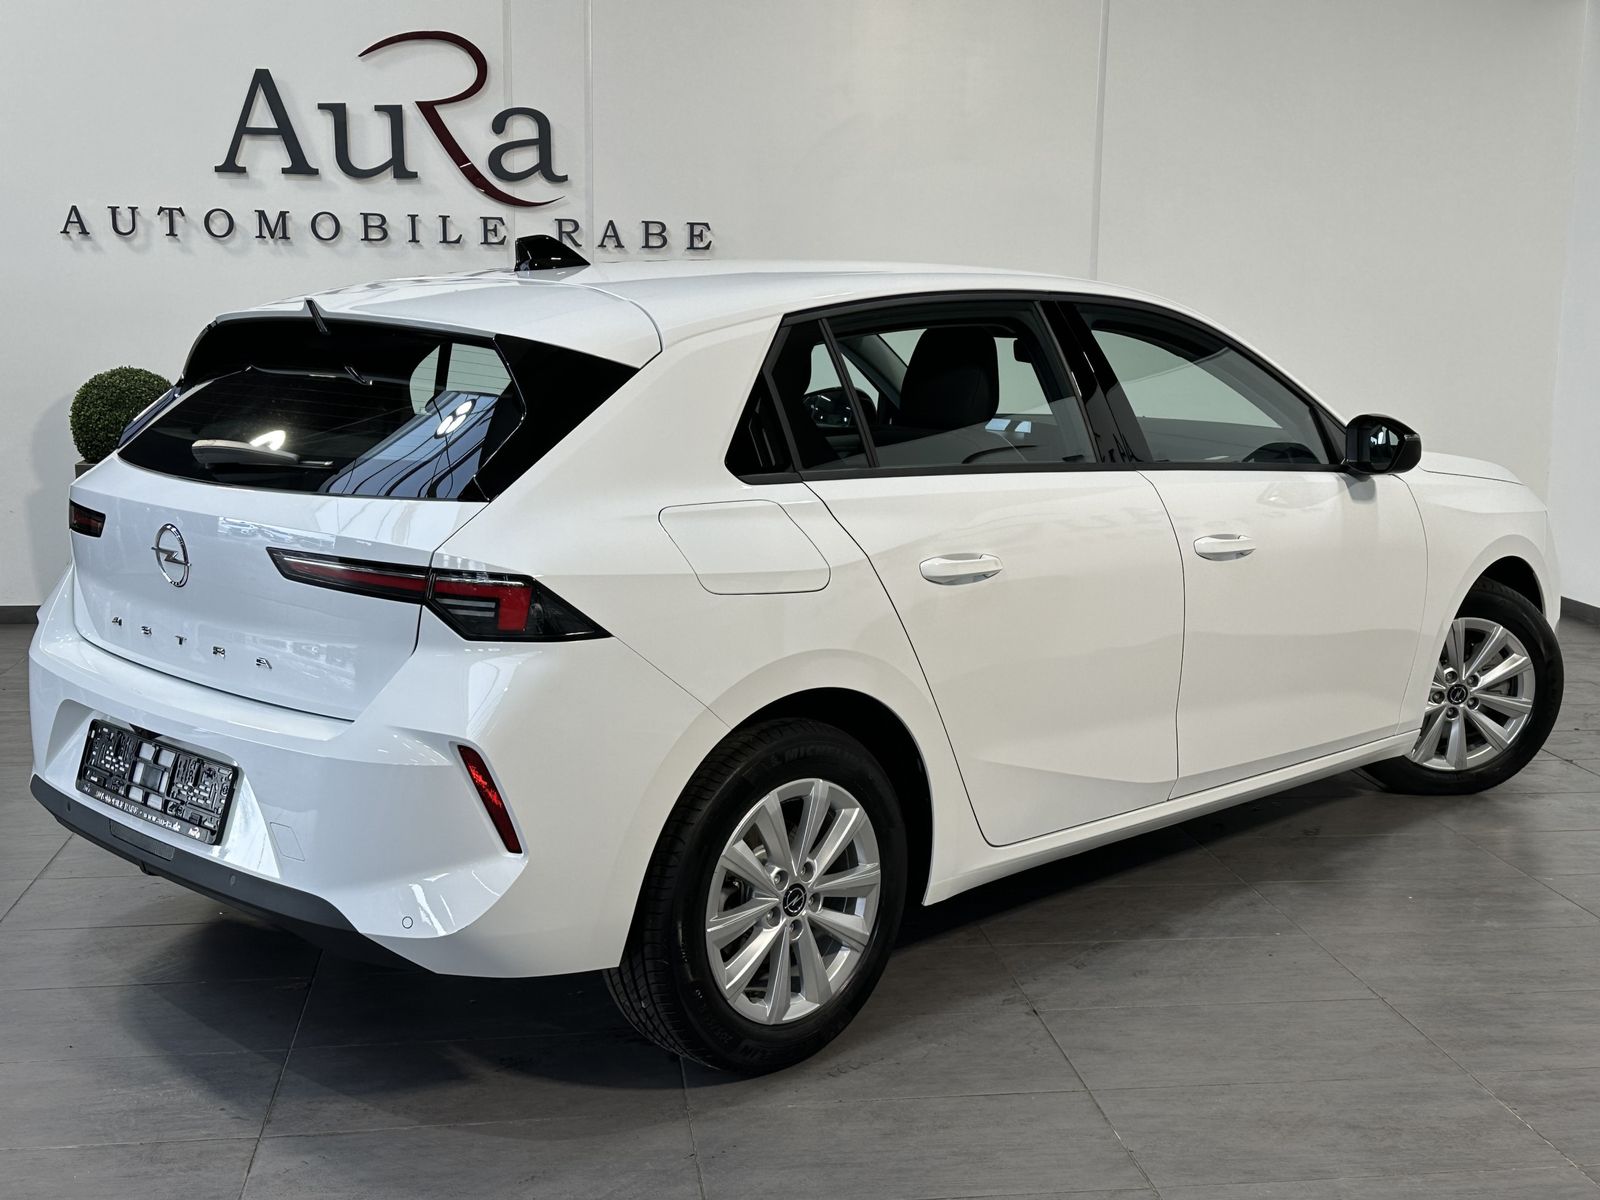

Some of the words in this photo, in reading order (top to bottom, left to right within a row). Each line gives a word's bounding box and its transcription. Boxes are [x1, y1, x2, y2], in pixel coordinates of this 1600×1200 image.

[214, 30, 569, 207] AuRa
[60, 205, 507, 245] AUTOMOBILE
[554, 218, 712, 250] RABE
[111, 616, 272, 669] ASTRA
